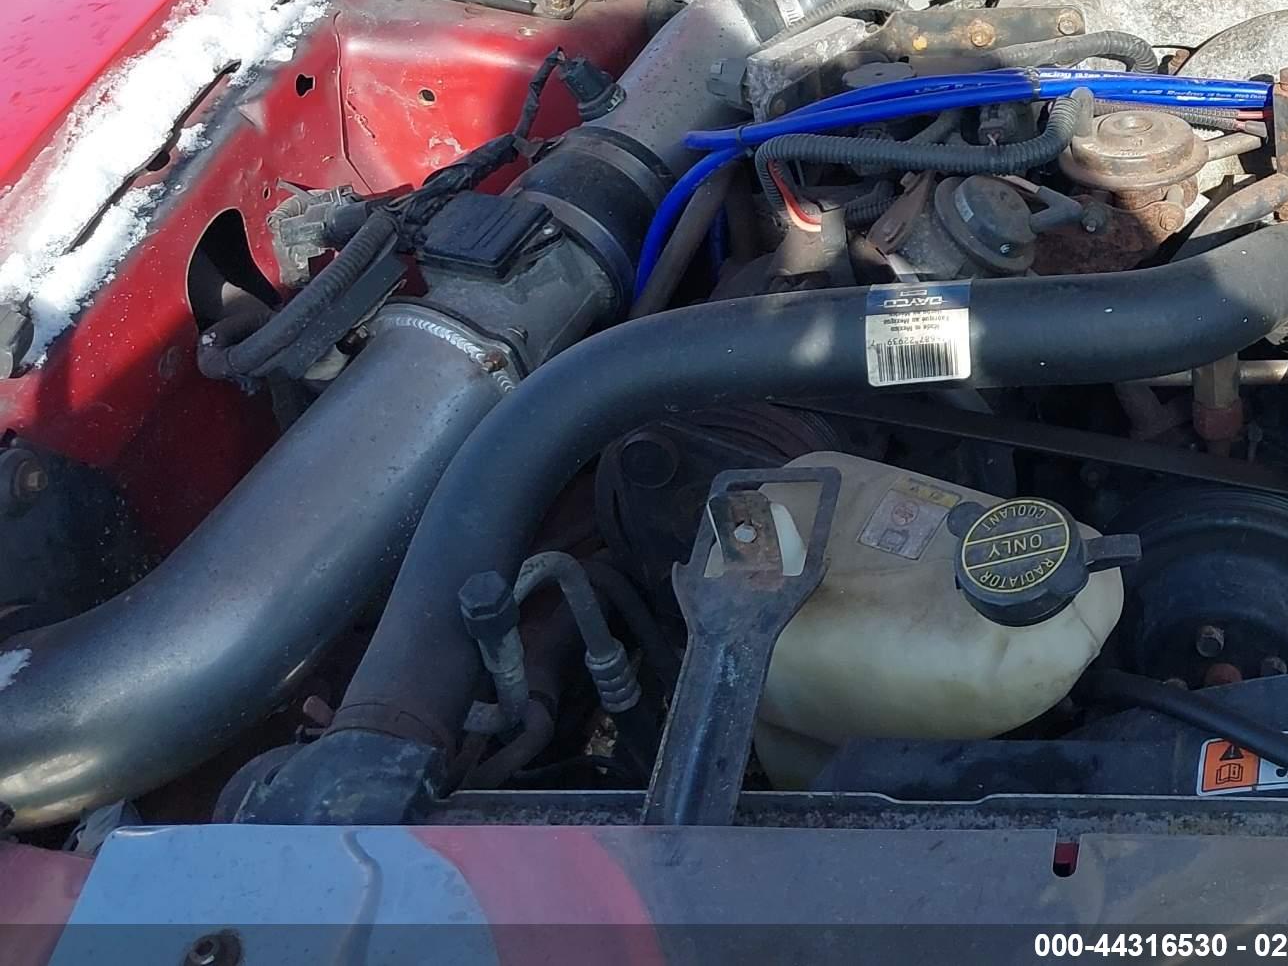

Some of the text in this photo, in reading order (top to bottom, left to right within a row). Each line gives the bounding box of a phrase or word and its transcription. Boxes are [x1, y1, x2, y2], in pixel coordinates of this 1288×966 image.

[884, 296, 943, 308] DAYCO
[981, 504, 1046, 532] COOLANT
[987, 534, 1042, 558] ONLY
[979, 558, 1055, 588] RADIATOR
